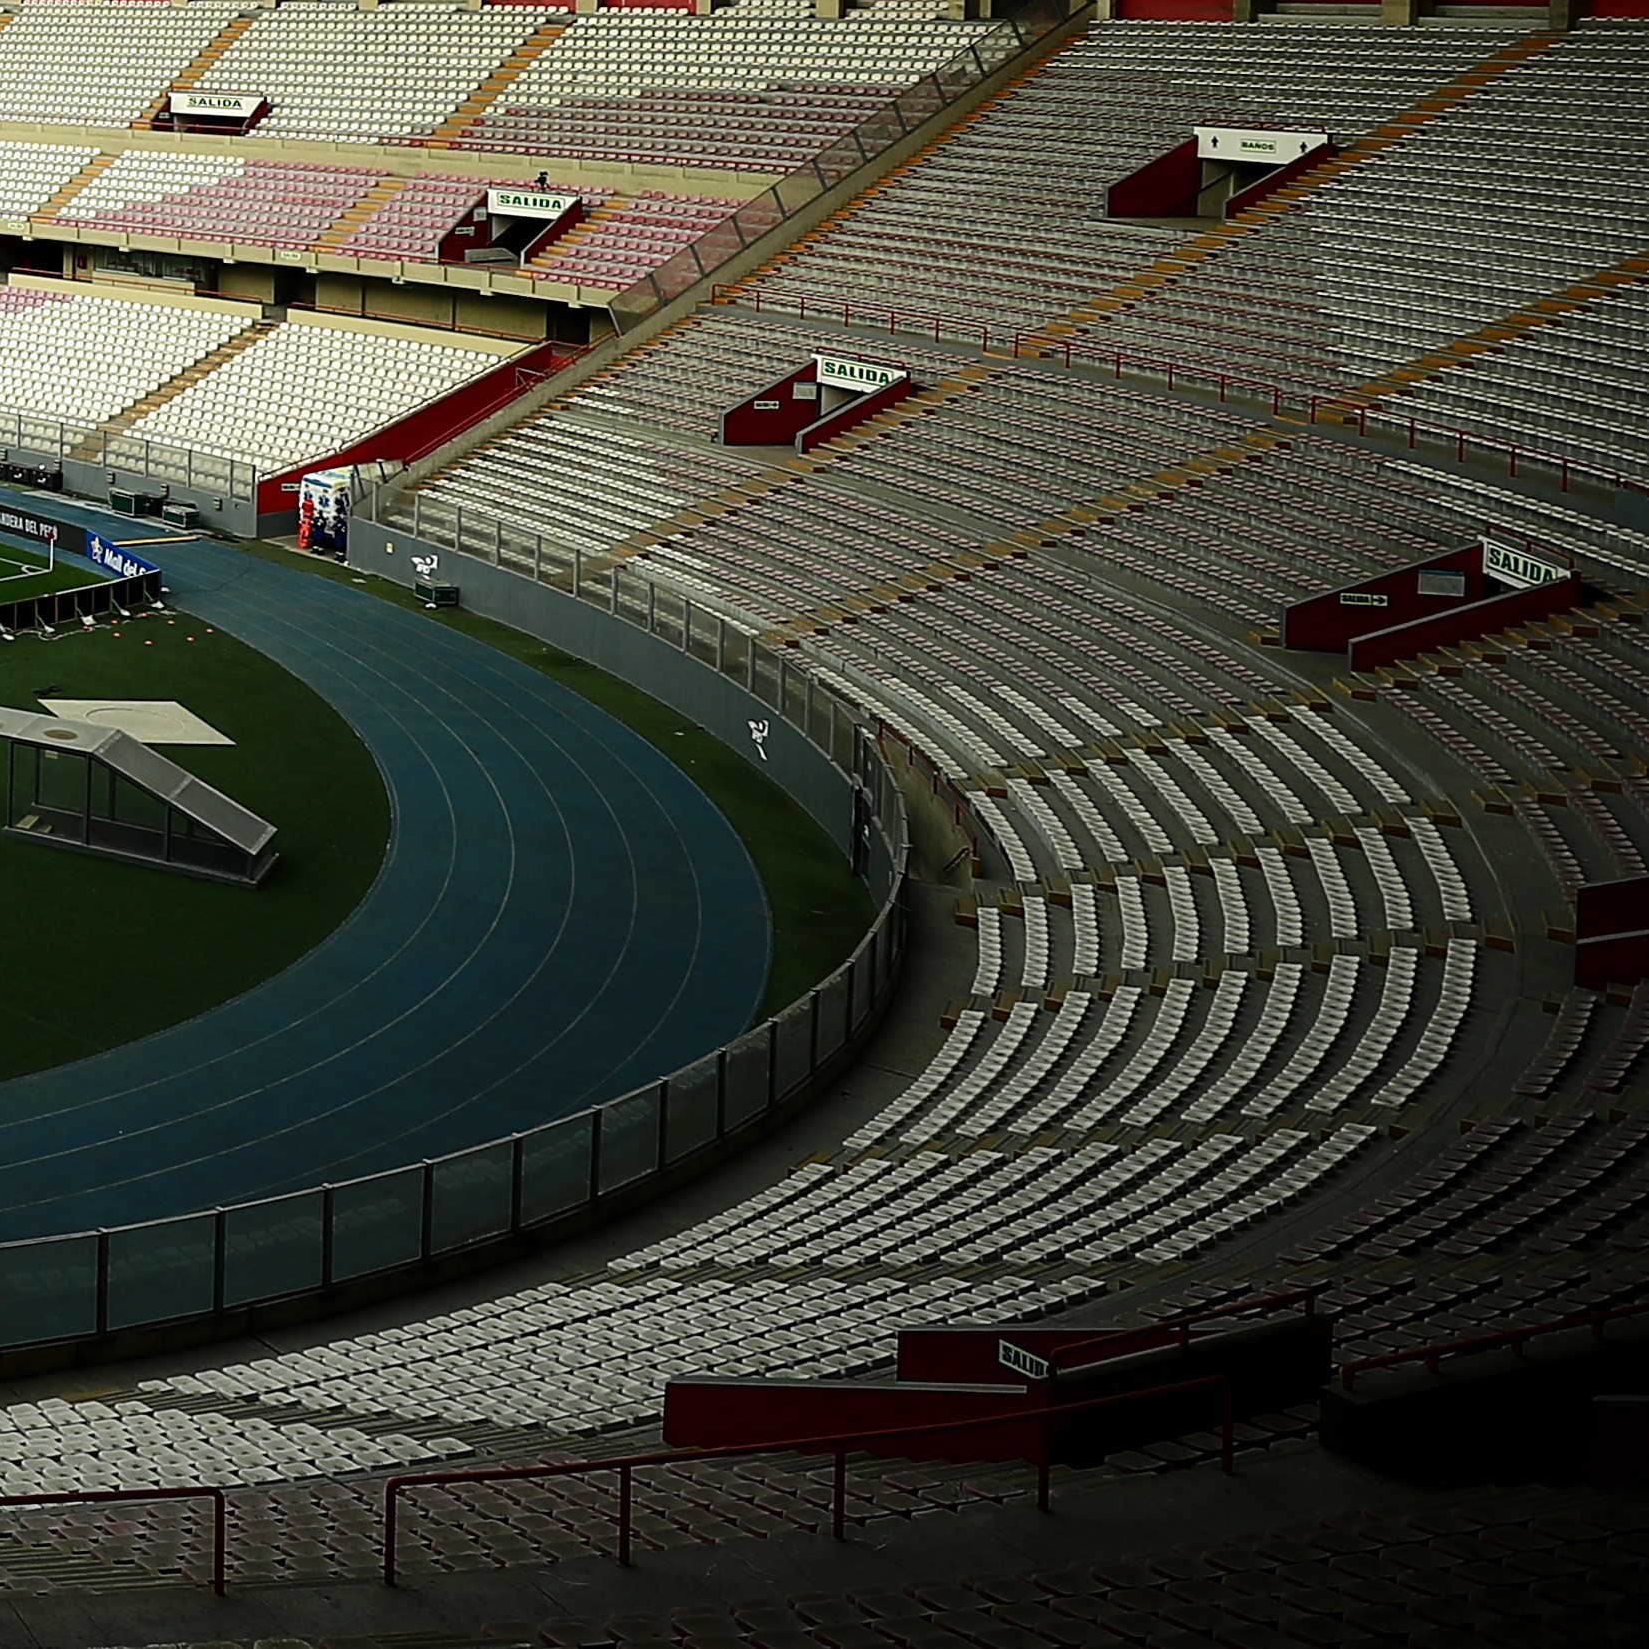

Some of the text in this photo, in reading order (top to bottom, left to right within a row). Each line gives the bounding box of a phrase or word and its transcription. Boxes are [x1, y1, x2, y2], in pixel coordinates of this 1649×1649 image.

[189, 97, 242, 108] SALIDA
[500, 195, 562, 209] SALIDA
[824, 361, 890, 384] SALIDA
[25, 516, 38, 534] DEL
[104, 548, 123, 573] Mall
[1490, 547, 1554, 582] SALIDA
[1002, 1346, 1044, 1377] SALID
